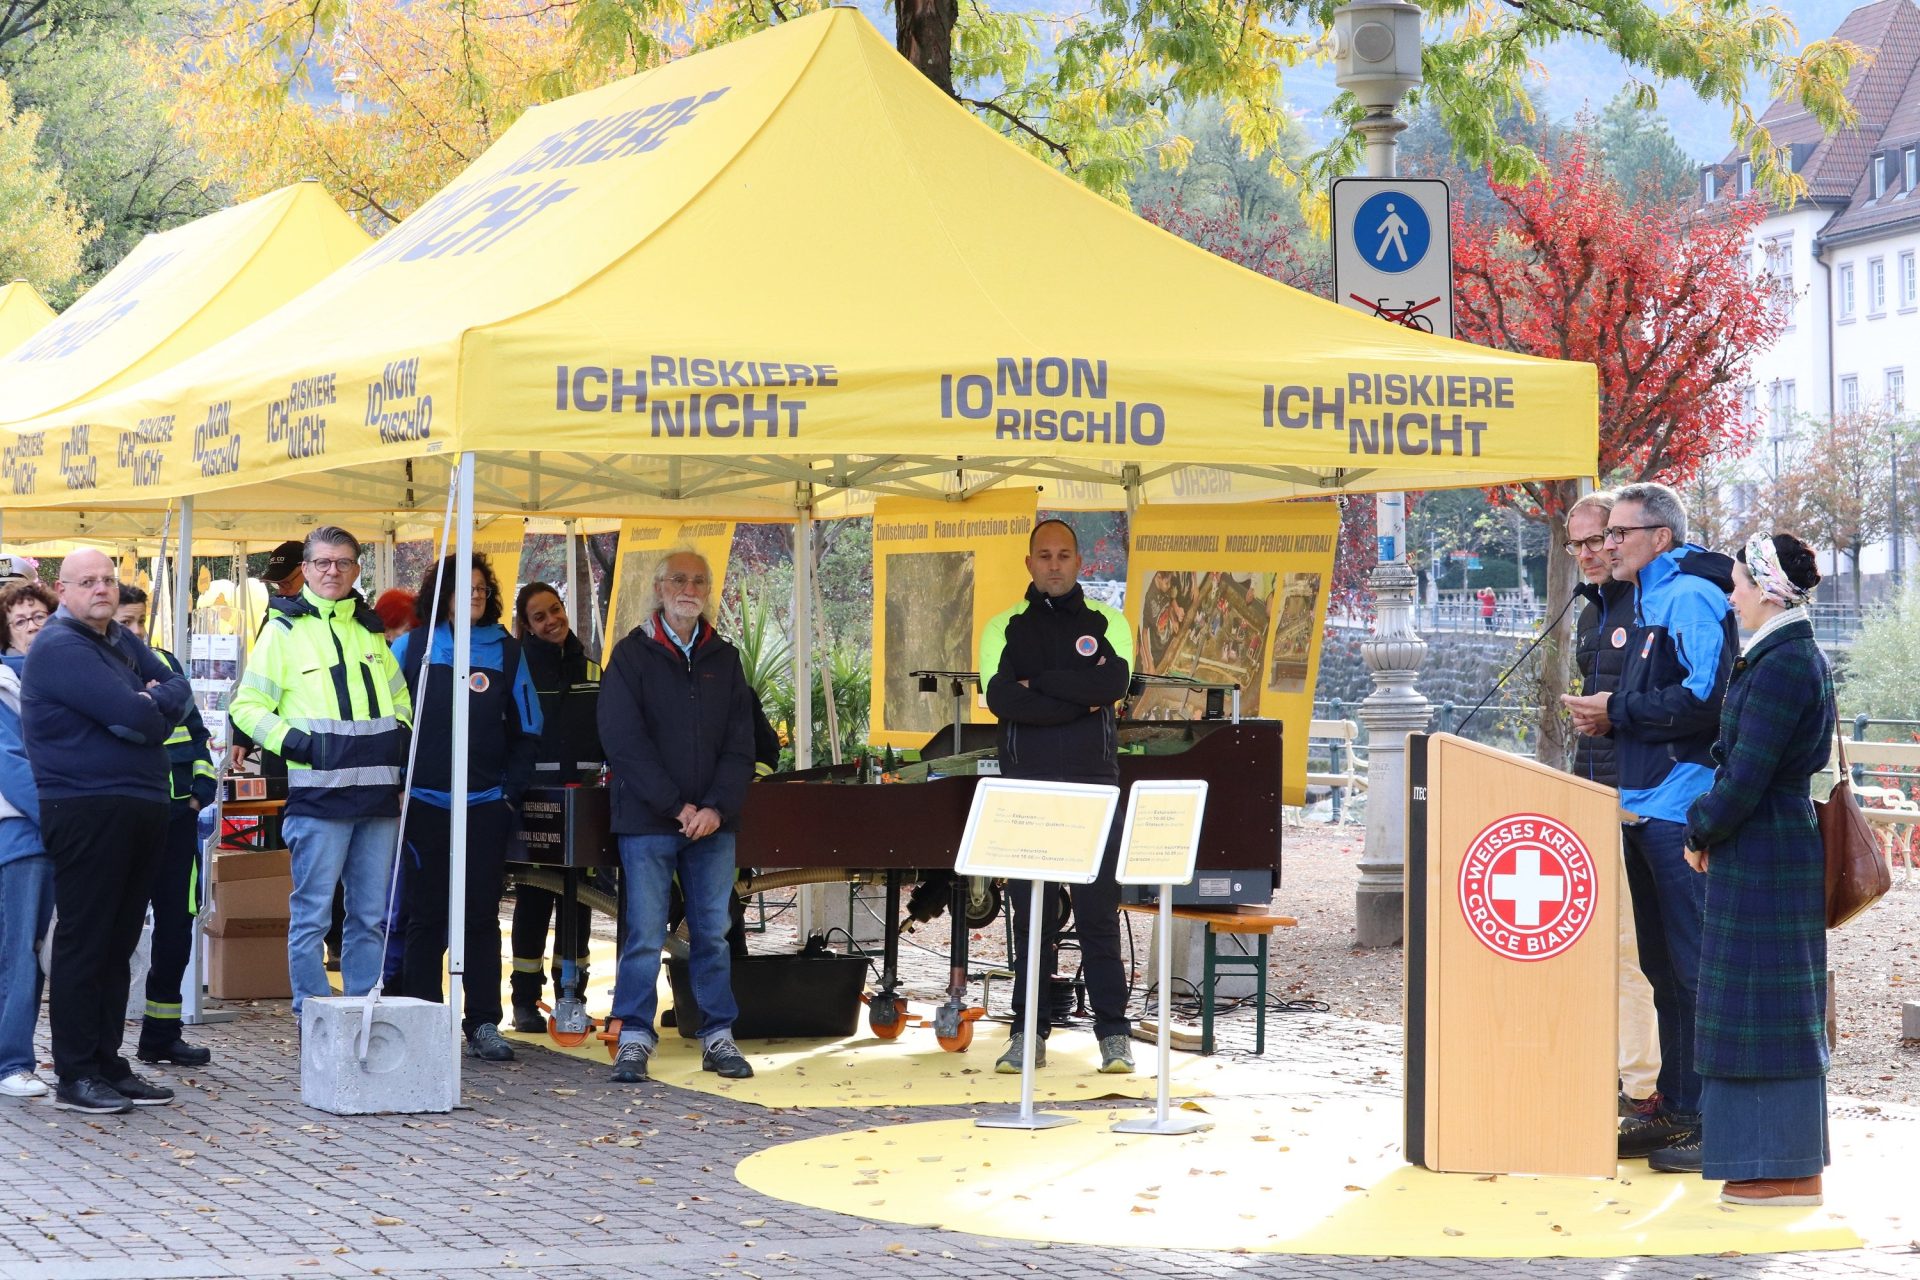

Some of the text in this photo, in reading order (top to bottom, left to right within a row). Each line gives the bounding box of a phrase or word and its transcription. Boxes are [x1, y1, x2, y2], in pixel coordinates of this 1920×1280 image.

[365, 356, 419, 427] IO NON
[556, 354, 839, 413] ICH RISKIERE
[940, 357, 1108, 419] IO NON
[1263, 372, 1515, 430] ICH RISKIERE
[267, 372, 336, 443] ICH RISKIERE
[380, 394, 432, 444] RISCHIO
[650, 393, 806, 437] NICHT
[995, 401, 1165, 446] RISCHIO
[70, 424, 90, 455] NON
[117, 415, 176, 468] ICH RISKIERE
[192, 400, 231, 463] IO NON
[288, 414, 326, 460] NICHT
[1348, 412, 1488, 457] NICHT
[13, 462, 37, 495] NICHT
[67, 455, 97, 489] RISCHIO
[133, 449, 164, 486] NICHT
[201, 434, 240, 477] RISCHIO
[876, 515, 1030, 541] Zivilschutzplan Piano di protezione civile
[1135, 535, 1332, 552] NATURGEFAHRENMODELL MODELLO PERICOLI NATURALI
[1467, 823, 1588, 882] WEISSES KREUZ
[1468, 893, 1588, 952] CROCE BIANCA
